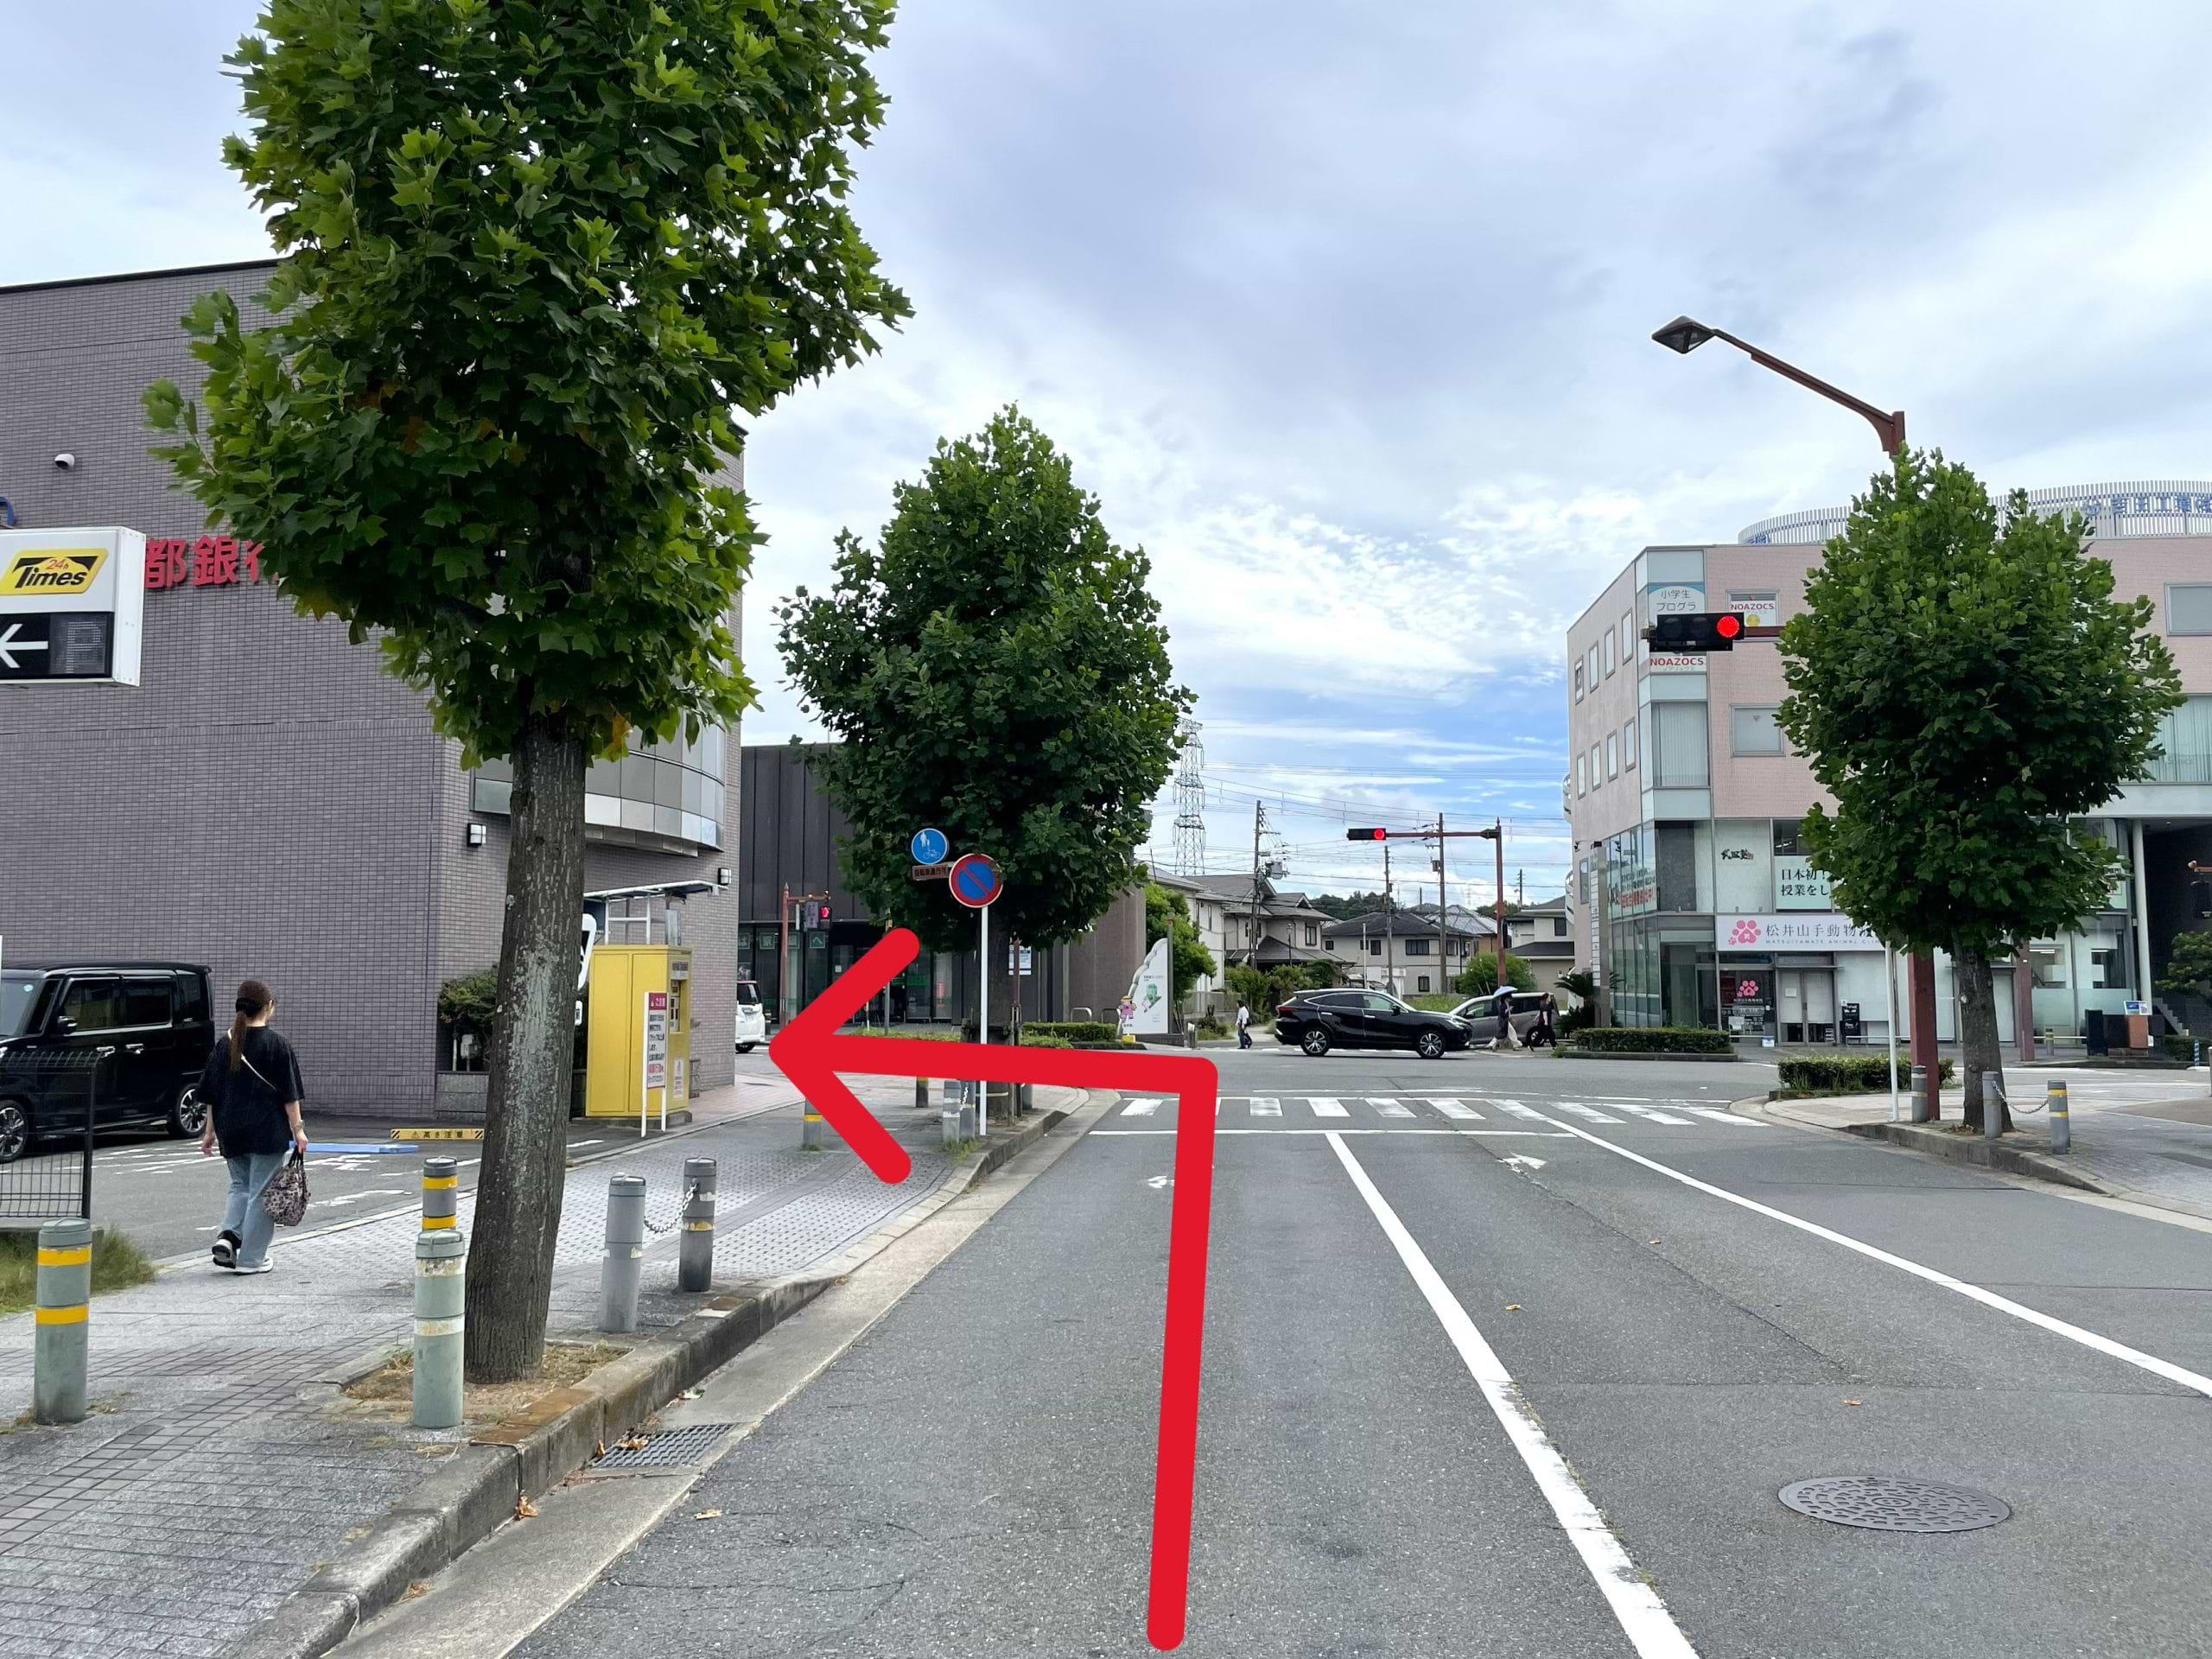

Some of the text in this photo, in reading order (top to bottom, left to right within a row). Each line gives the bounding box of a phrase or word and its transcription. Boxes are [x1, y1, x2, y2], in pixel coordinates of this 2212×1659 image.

[45, 558, 69, 570] 24h
[15, 565, 87, 588] Times
[1661, 589, 1691, 599] 小学生
[1650, 657, 1704, 666] NOAZOCS
[1781, 884, 1829, 896] 授業をし
